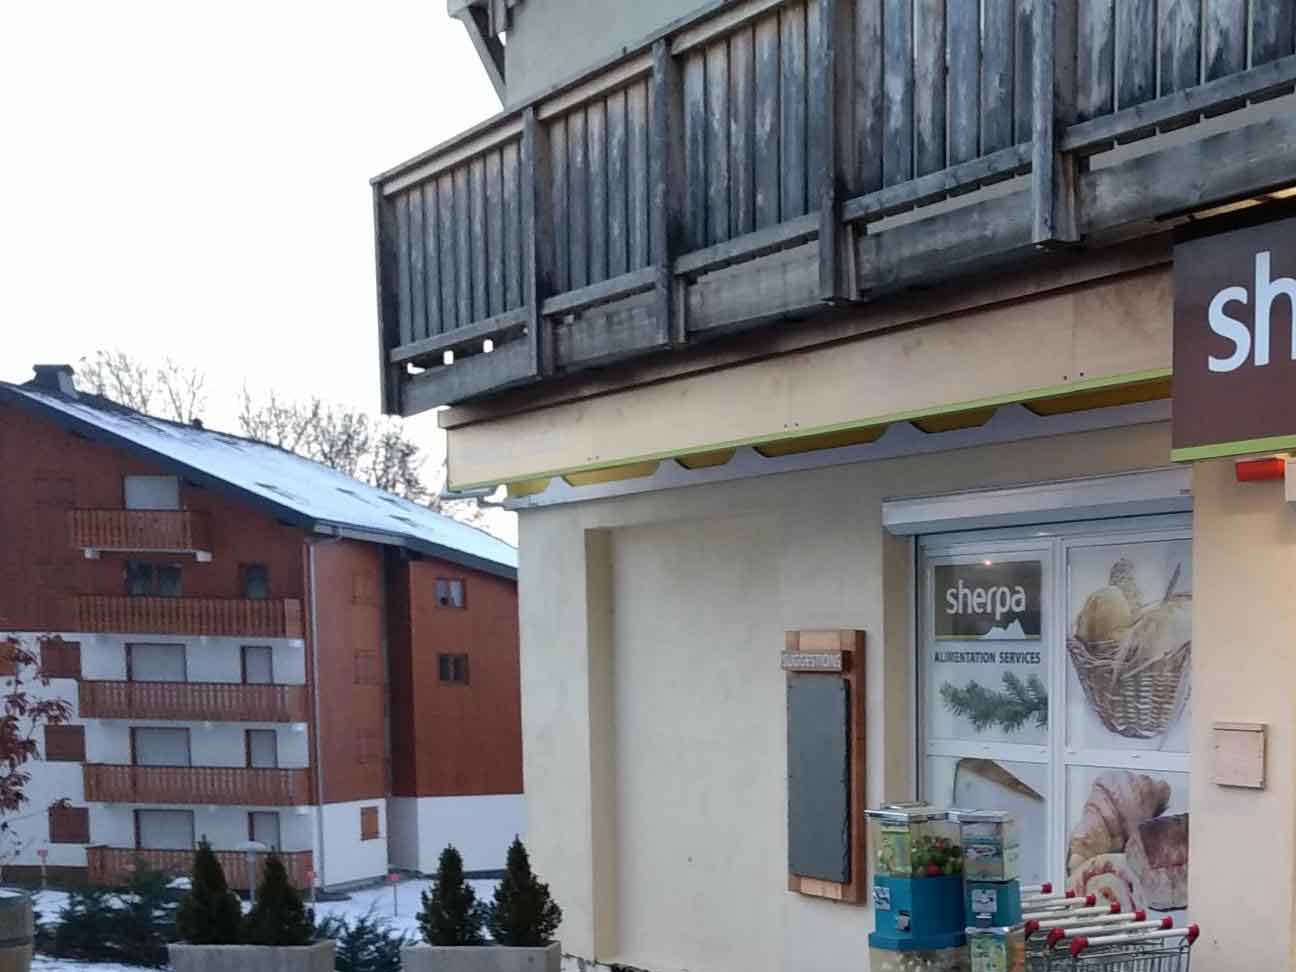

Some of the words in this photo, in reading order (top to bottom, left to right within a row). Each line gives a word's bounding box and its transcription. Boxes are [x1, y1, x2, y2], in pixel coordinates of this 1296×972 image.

[946, 580, 1026, 620] sherpa
[934, 651, 996, 664] ALIMENTATION
[999, 651, 1041, 664] SERVICES
